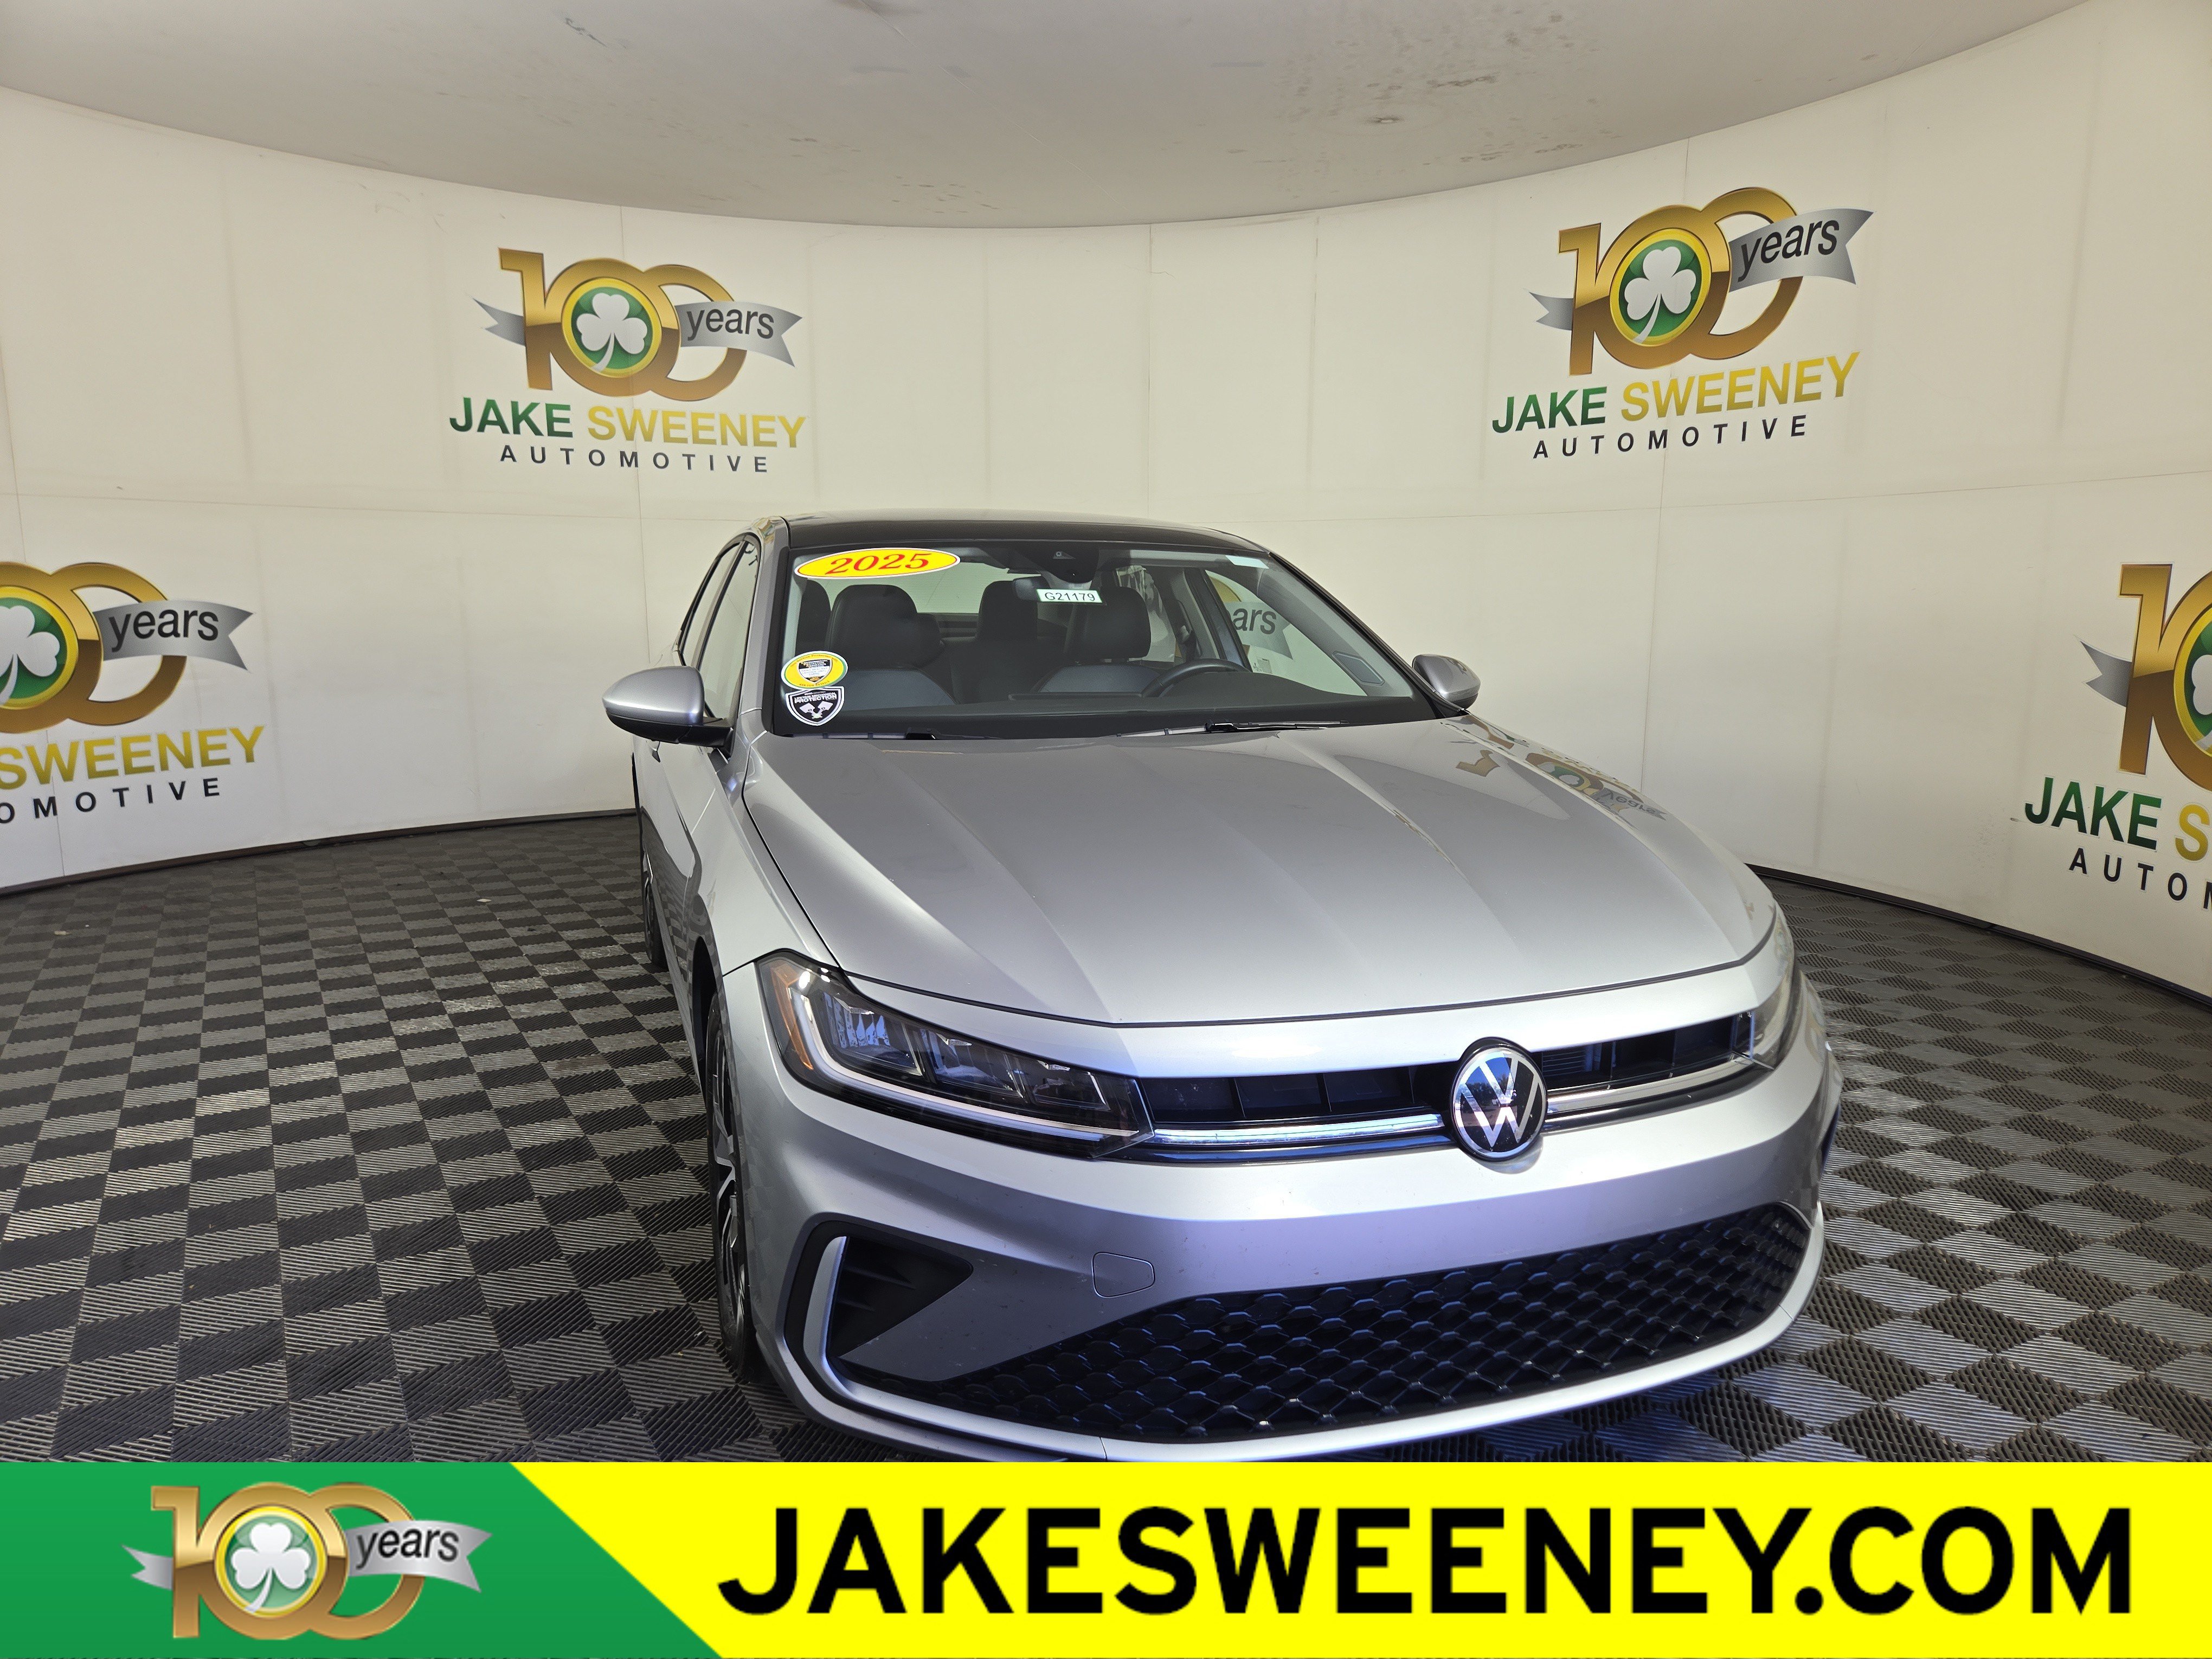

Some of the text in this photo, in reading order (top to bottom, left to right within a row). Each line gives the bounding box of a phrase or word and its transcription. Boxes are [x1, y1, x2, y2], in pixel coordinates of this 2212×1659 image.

[1738, 220, 1840, 282] years
[687, 308, 774, 340] years
[1492, 352, 1860, 433] JAKE SWEENEY
[449, 397, 806, 448] JAKE SWEENEY
[1533, 415, 1806, 459] AUTOMOTIVE
[500, 445, 767, 473] AUTOMOTIVE
[825, 553, 933, 575] 2025
[1045, 593, 1095, 601] G21179
[110, 609, 218, 652] years
[1227, 608, 1277, 635] ars
[2025, 777, 2162, 850] JAKE
